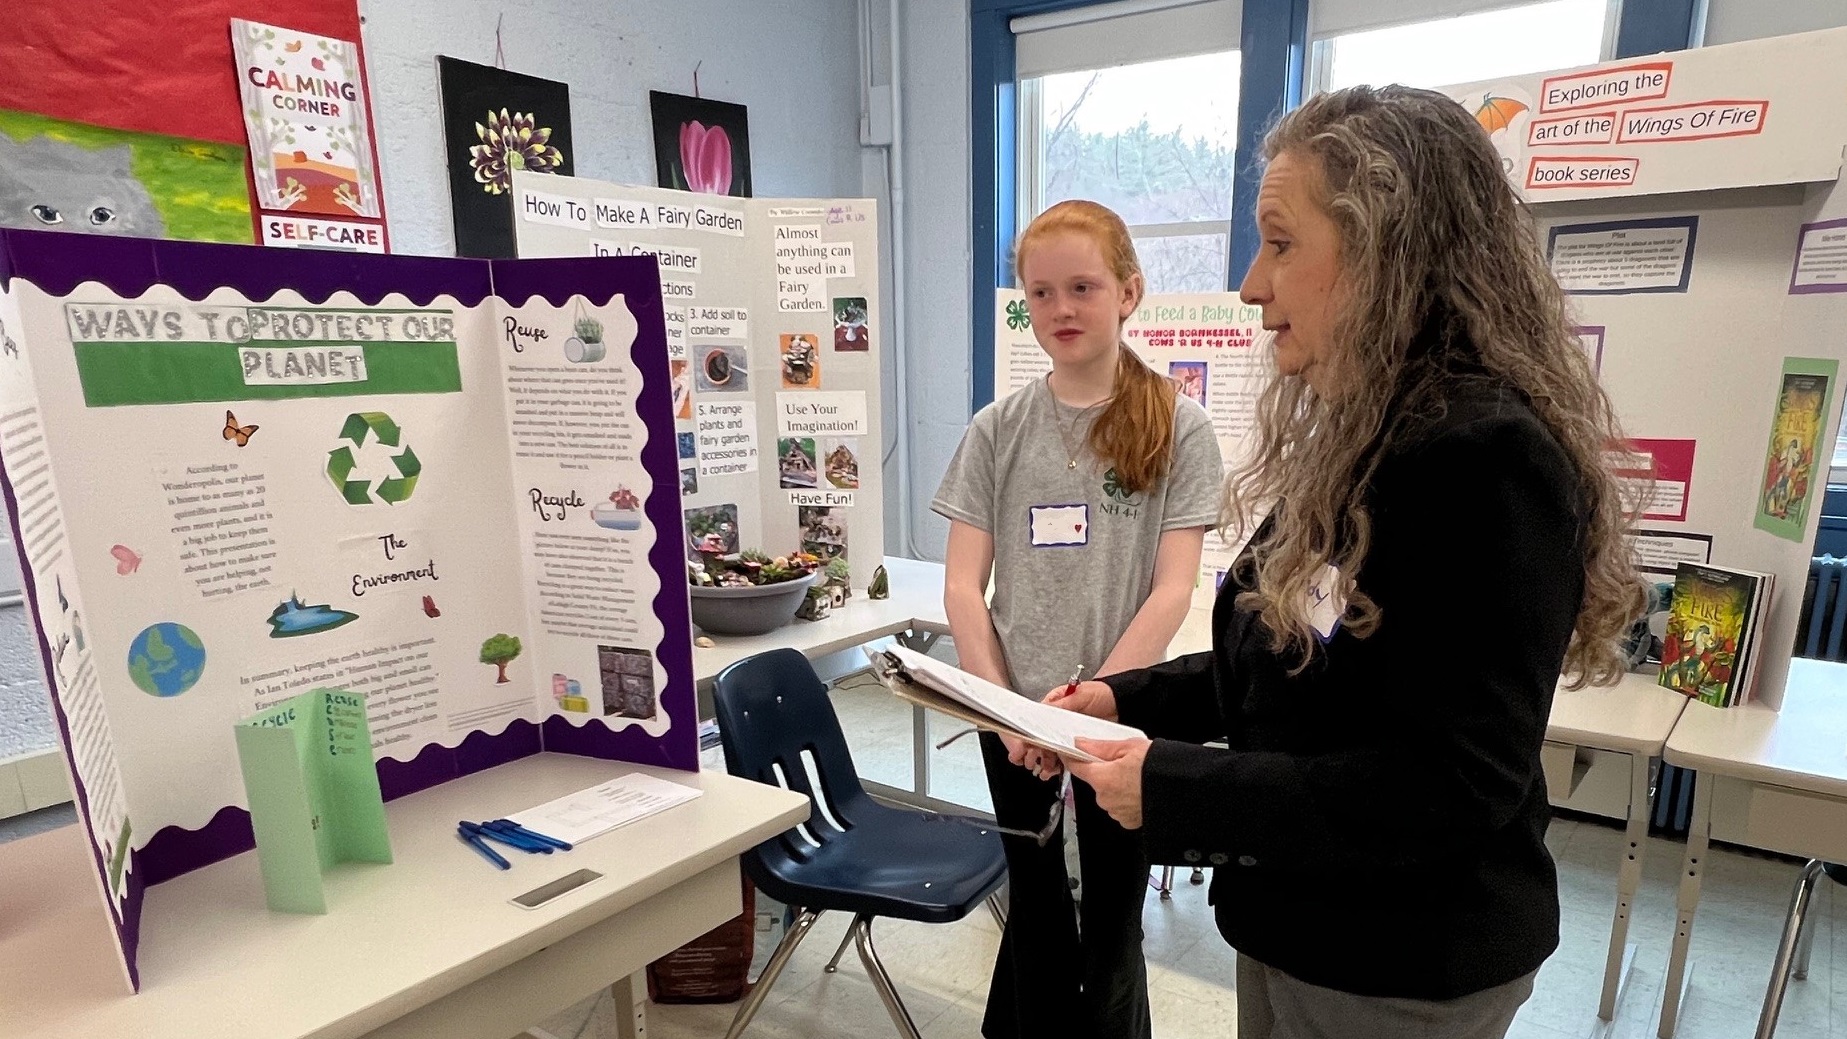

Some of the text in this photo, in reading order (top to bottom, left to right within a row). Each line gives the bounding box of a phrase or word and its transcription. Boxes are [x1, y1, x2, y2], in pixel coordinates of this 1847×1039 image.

[248, 66, 356, 102] CALMING
[1548, 73, 1664, 105] Exploring the
[272, 94, 341, 118] CORNER
[1535, 108, 1757, 140] art of the Wings Of Fire
[1534, 165, 1631, 182] book series
[526, 195, 742, 231] How To Make A Fairy Garden
[270, 221, 379, 246] SELF-CARE
[776, 227, 819, 239] Almost
[594, 243, 609, 257] In
[776, 245, 851, 260] anything can
[778, 262, 847, 275] be used in a
[779, 281, 809, 295] Fairy
[780, 298, 826, 310] Garden.
[690, 308, 698, 320] 3.
[702, 308, 718, 320] Add
[721, 309, 735, 320] soil
[737, 311, 747, 320] to
[1155, 306, 1185, 323] Feed
[1189, 307, 1197, 321] a
[1201, 305, 1234, 324] Baby
[71, 307, 457, 344] WAYS TO PROTECT OUR
[690, 325, 730, 336] container
[1143, 329, 1175, 337] HONOR
[503, 316, 549, 353] Reuse
[1149, 339, 1174, 347] COWS
[1191, 339, 1202, 347] US
[243, 351, 363, 382] PLANET
[699, 404, 742, 417] 5. Arrange
[786, 403, 838, 415] Use Your
[699, 418, 743, 432] plants and
[787, 420, 859, 433] Imagination!
[700, 433, 750, 447] fairy garden
[701, 446, 758, 461] accessories in
[186, 463, 229, 475] According
[702, 463, 748, 475] a container
[225, 477, 239, 485] our
[241, 474, 265, 484] planet
[176, 494, 200, 504] home
[202, 493, 211, 501] to
[222, 488, 244, 499] many
[790, 493, 852, 505] Have Fun!
[174, 499, 265, 520] quintillion animals and
[529, 488, 585, 522] Recycle
[1099, 502, 1119, 515] NH
[171, 524, 192, 534] even
[193, 521, 214, 531] more
[244, 514, 258, 523] and
[189, 536, 203, 546] big
[203, 535, 218, 545] job
[228, 530, 248, 540] keep
[249, 526, 269, 535] them
[201, 547, 218, 556] This
[220, 539, 268, 556] presentation
[378, 533, 408, 561] The
[184, 551, 277, 574] about how to make sure
[195, 577, 211, 587] you
[213, 574, 225, 582] are
[259, 565, 272, 573] not
[352, 559, 440, 597] Environment
[235, 583, 247, 591] the
[240, 676, 250, 685] In
[294, 660, 326, 673] keeping
[327, 656, 340, 665] the
[341, 652, 361, 662] earth
[362, 646, 390, 658] healthy
[255, 687, 266, 696] As
